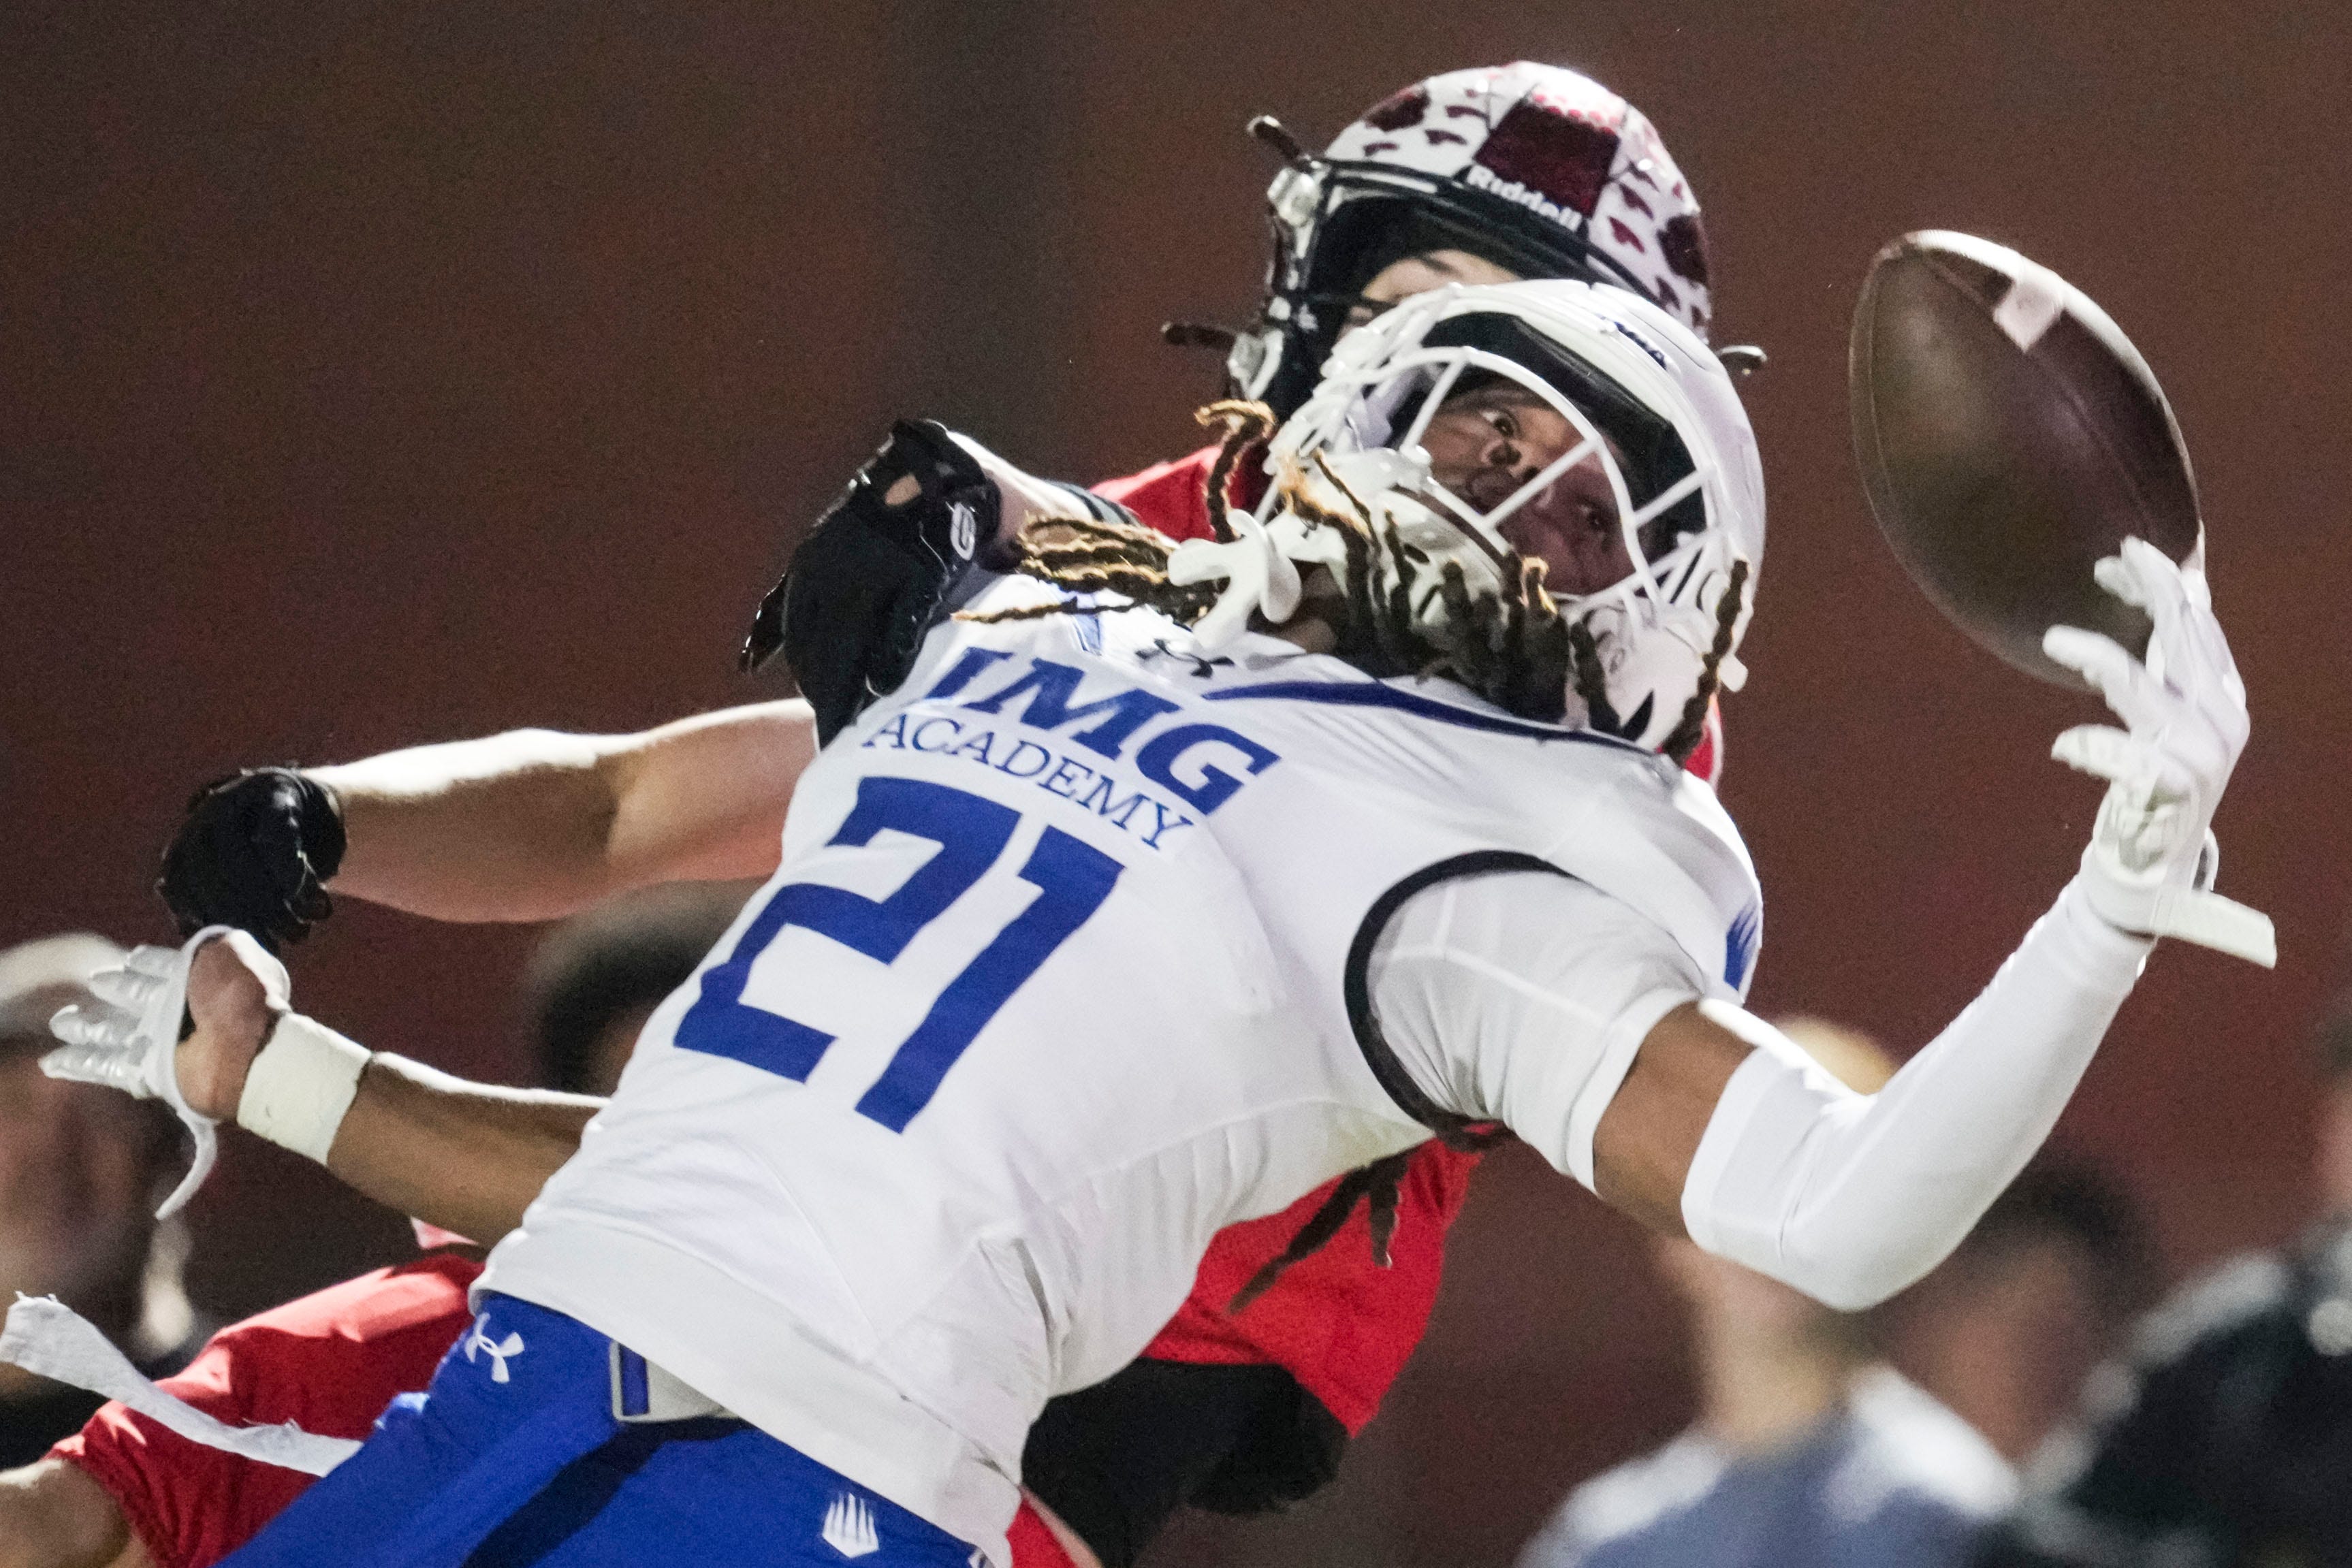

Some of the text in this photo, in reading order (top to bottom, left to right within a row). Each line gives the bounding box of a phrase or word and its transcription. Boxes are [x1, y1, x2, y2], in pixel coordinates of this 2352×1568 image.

[1467, 165, 1582, 231] Riddell
[861, 714, 1193, 850] ACADEMY
[925, 647, 1282, 815] IMG
[673, 776, 1126, 1134] 21
